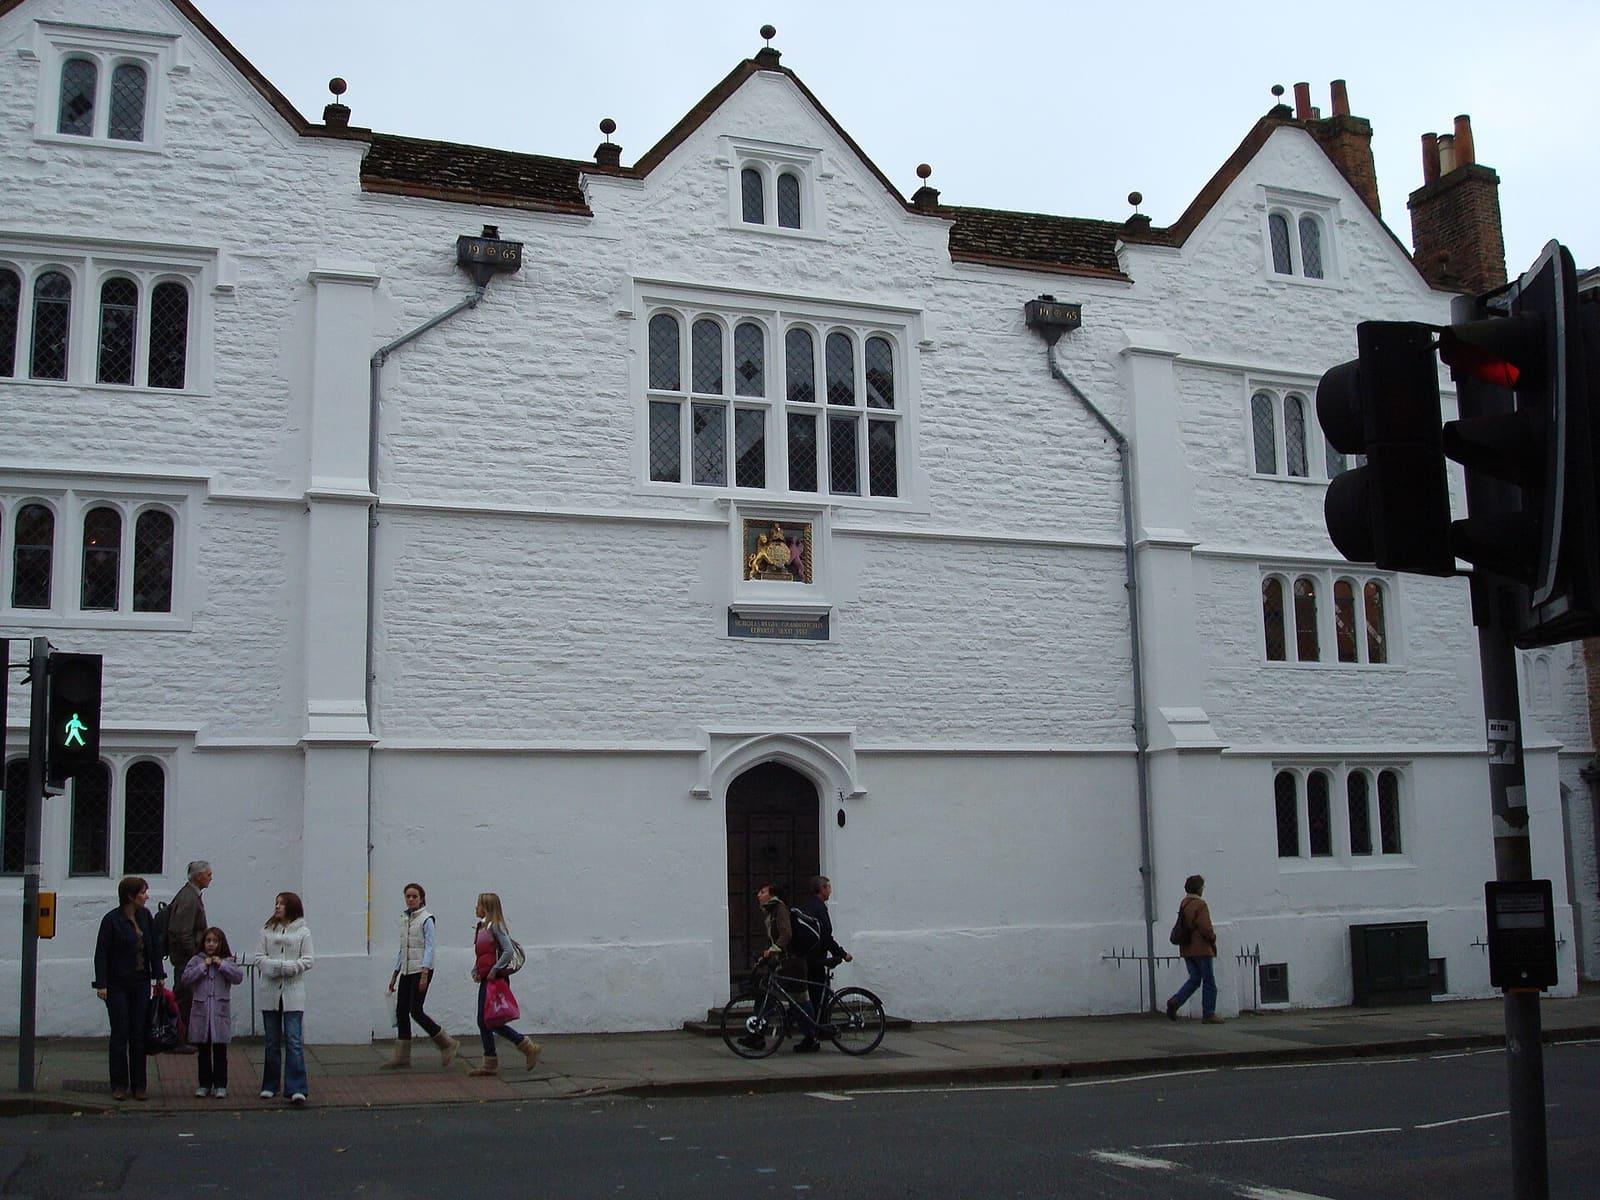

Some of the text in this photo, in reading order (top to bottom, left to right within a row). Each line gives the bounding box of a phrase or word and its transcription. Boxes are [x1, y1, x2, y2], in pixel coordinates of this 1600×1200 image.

[467, 244, 516, 260] 19 65
[1066, 311, 1077, 321] 65
